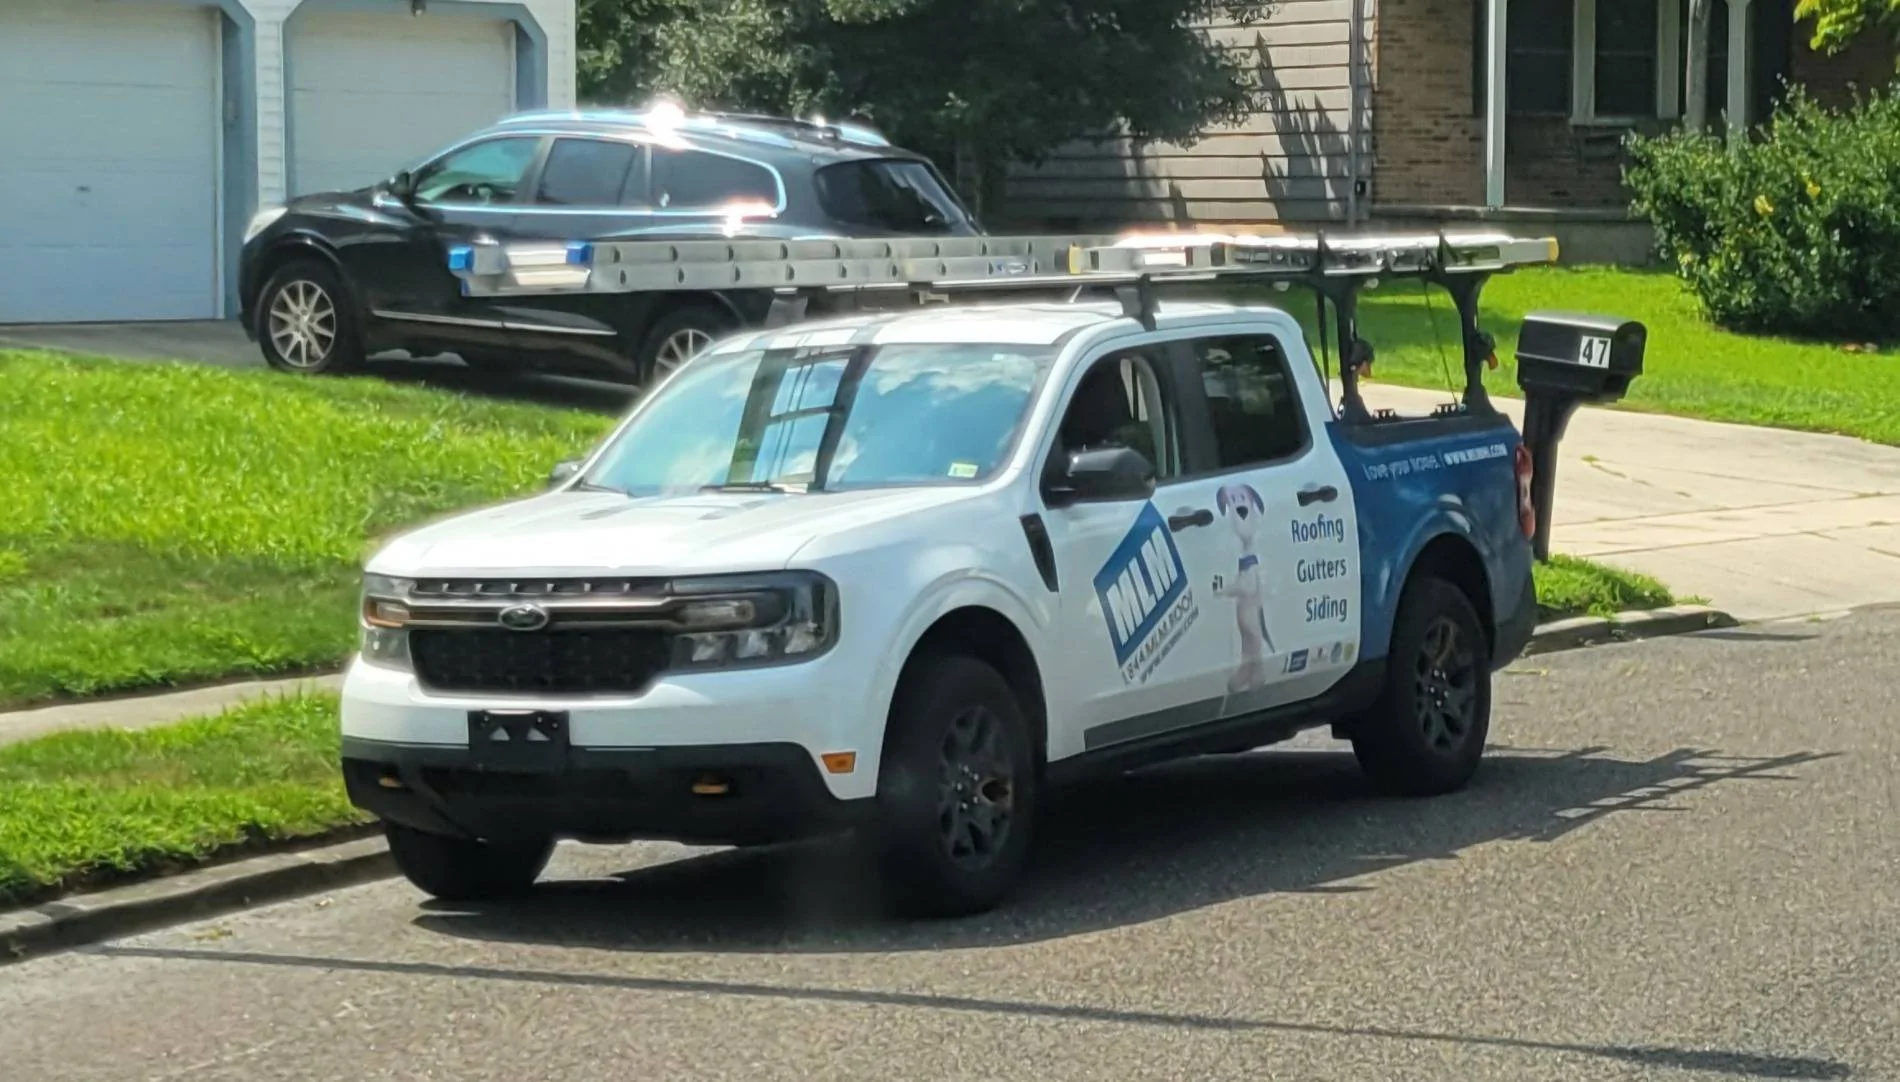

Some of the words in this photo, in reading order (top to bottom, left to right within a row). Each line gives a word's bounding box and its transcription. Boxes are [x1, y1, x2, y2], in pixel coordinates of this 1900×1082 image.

[1582, 338, 1609, 365] 47
[1291, 514, 1345, 543] Roofing
[1106, 525, 1178, 646] MLM
[1296, 559, 1347, 584] Gutters
[1305, 596, 1348, 624] Siding
